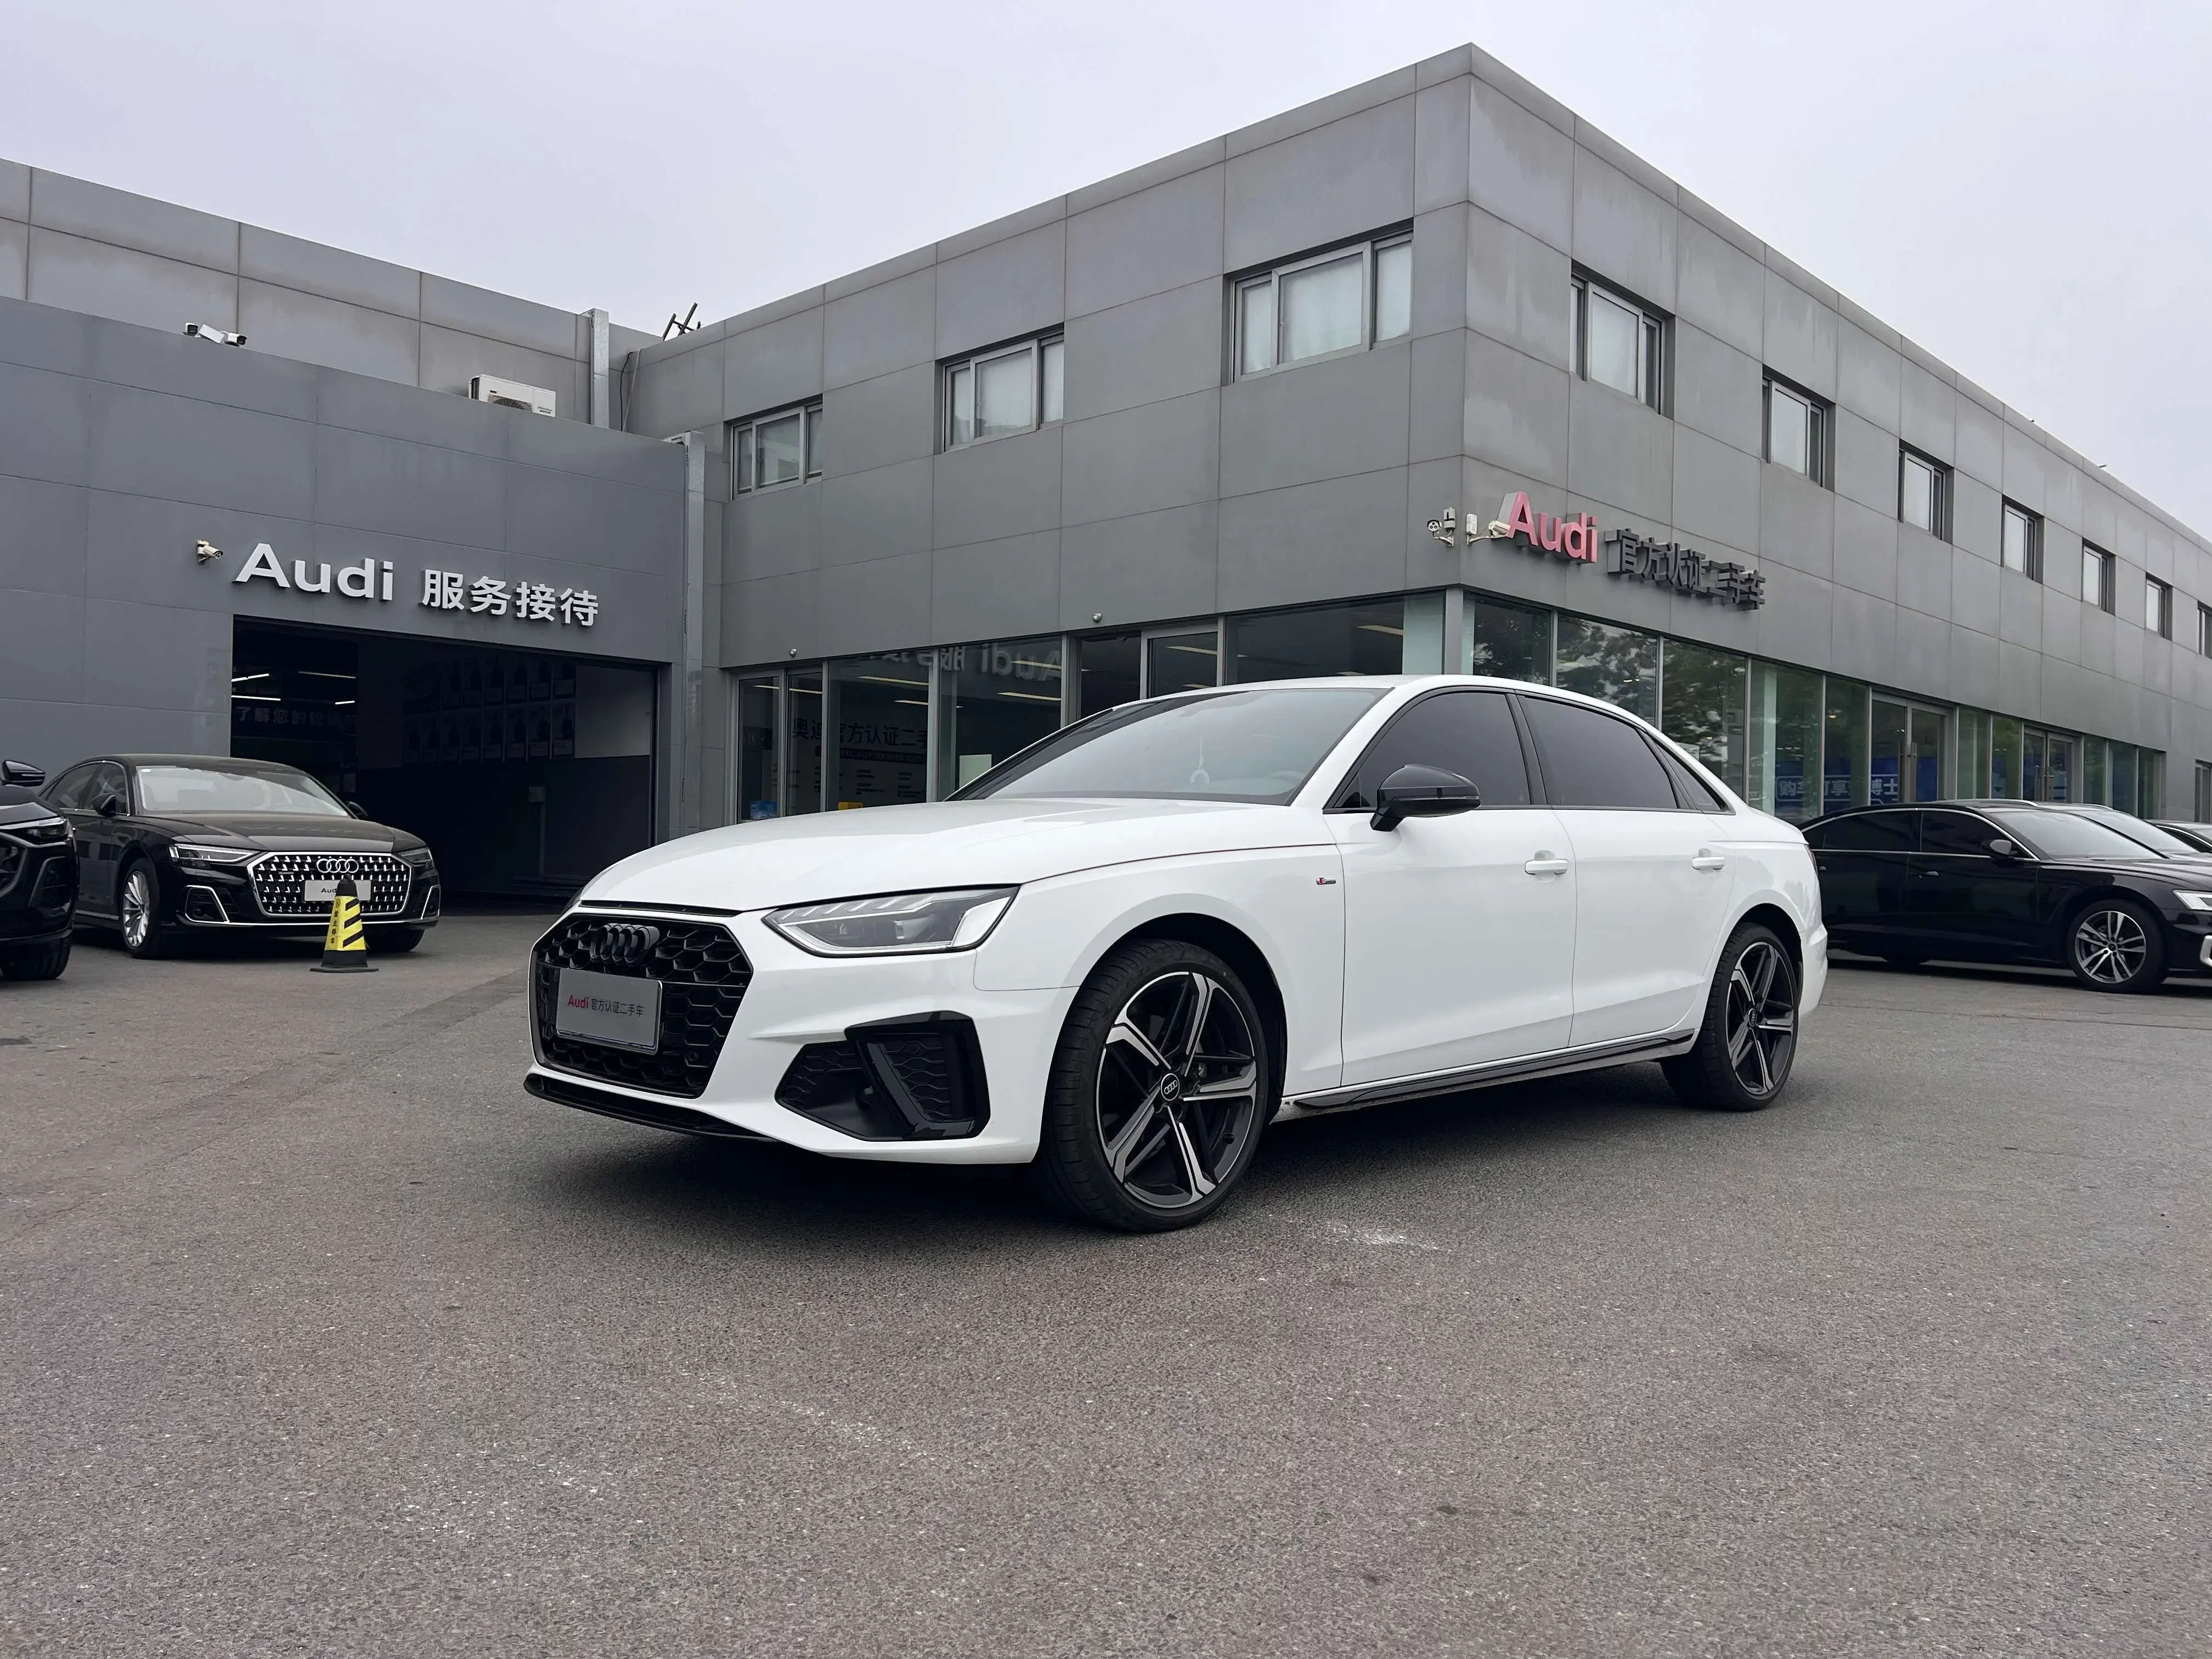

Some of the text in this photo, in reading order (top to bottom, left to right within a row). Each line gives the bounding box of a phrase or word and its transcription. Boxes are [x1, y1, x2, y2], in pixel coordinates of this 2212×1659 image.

[233, 542, 599, 627] Audi 服务接待
[1505, 491, 1766, 609] Audi 官方认证二手车
[567, 994, 645, 1017] Audi 官方认证二手车
